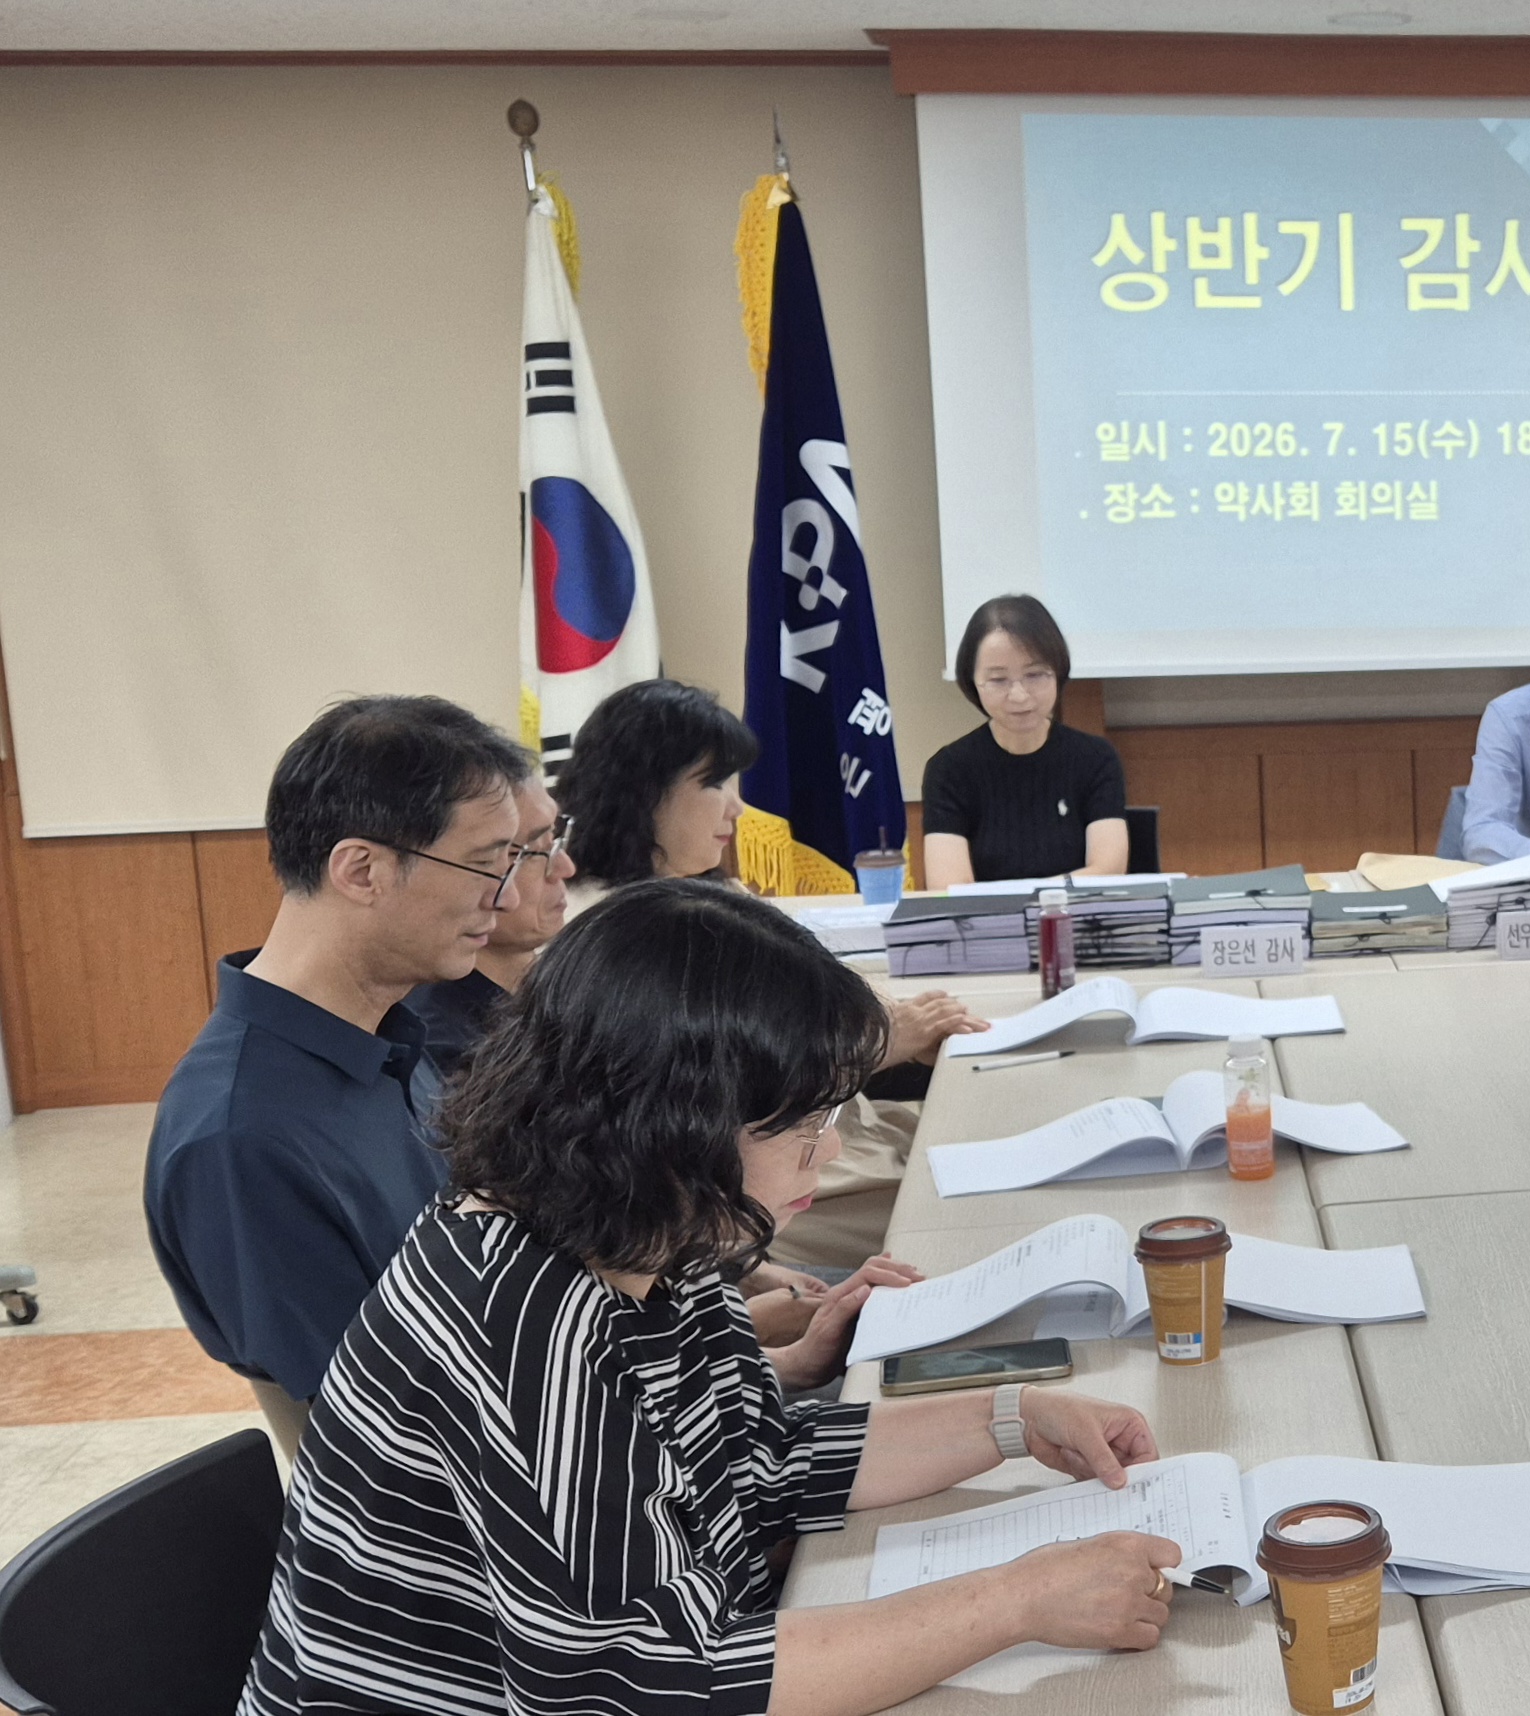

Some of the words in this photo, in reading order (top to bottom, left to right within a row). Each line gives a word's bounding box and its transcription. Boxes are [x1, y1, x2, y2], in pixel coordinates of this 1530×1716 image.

[1091, 211, 1354, 312] 상반기
[1095, 420, 1167, 462] 일시
[1206, 421, 1309, 457] 2026.
[1322, 421, 1356, 457] 7.
[1372, 418, 1480, 460] 15(수)
[1103, 481, 1177, 524] 장소
[1213, 480, 1320, 522] 약사회
[1334, 479, 1440, 521] 회의실
[1212, 939, 1256, 966] 장은선
[1266, 937, 1295, 963] 감사
